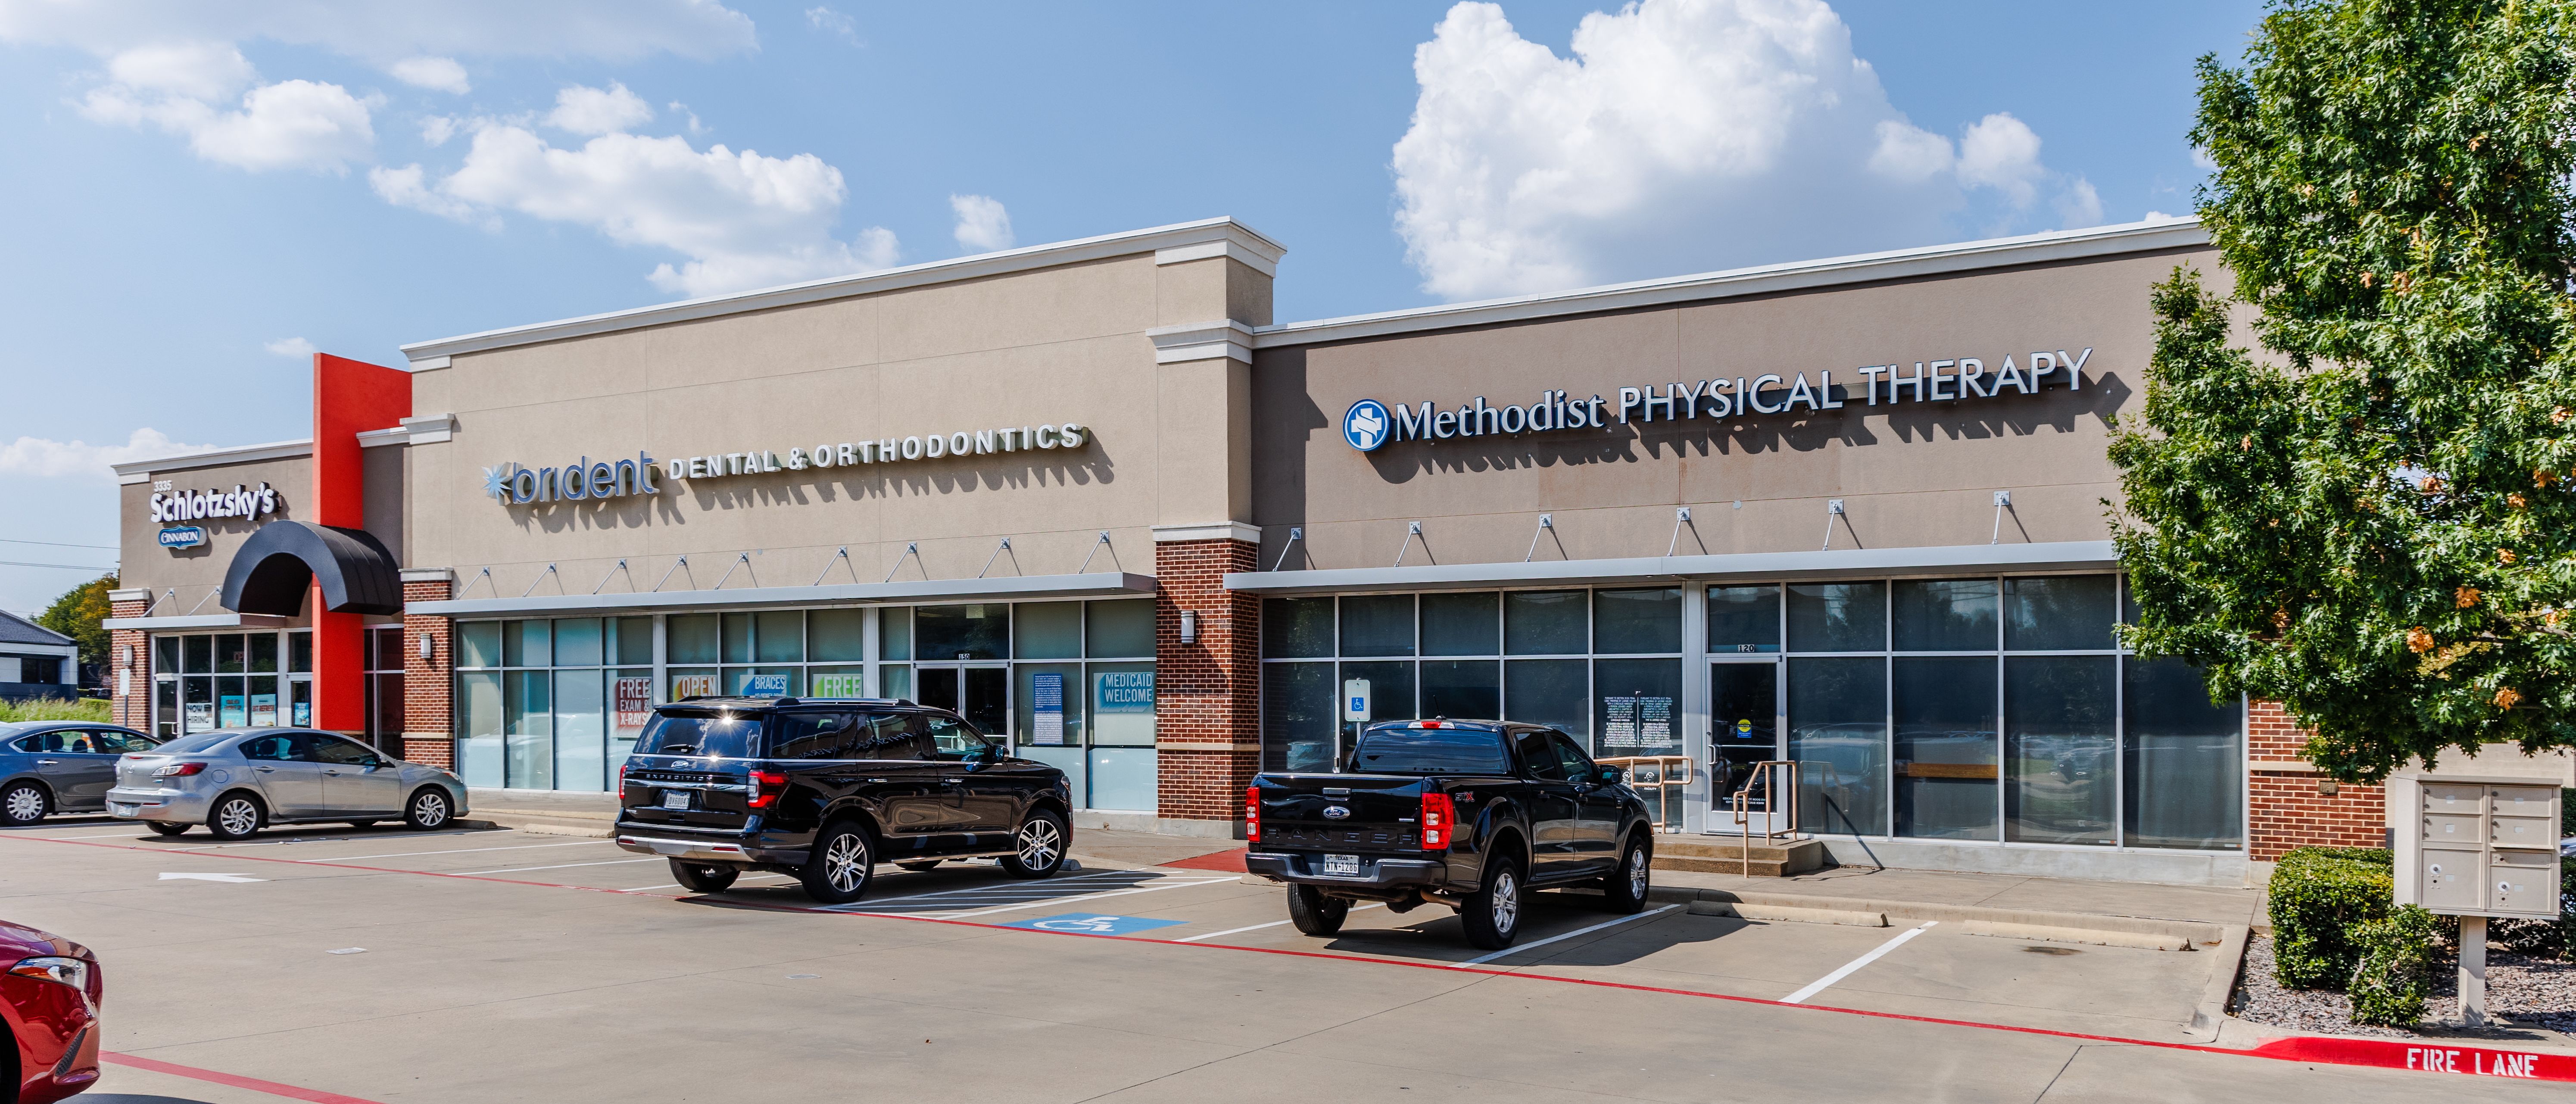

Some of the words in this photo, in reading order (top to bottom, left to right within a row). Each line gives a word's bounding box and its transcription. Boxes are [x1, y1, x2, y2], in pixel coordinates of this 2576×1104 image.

[1396, 389, 1607, 442] Methodist
[1619, 370, 1844, 424] PHYSICAL
[1858, 347, 2093, 406] THERAPY
[669, 449, 782, 480] DENTAL
[789, 447, 808, 470] &
[814, 422, 1083, 468] ORTHODONTICS
[512, 450, 660, 505] brident
[153, 480, 172, 492] 3335
[150, 481, 277, 523] Schlotzsky's
[161, 531, 198, 543] CINNABON
[682, 676, 716, 697] OPEN
[755, 676, 786, 689] BRACES
[824, 676, 861, 698] FREE
[1106, 674, 1152, 687] MEDICAID
[620, 679, 650, 699] FREE
[1105, 688, 1153, 702] WELCOME
[187, 705, 203, 713] NOW
[621, 699, 641, 712] EXAM
[643, 699, 649, 712] &
[621, 713, 647, 725] X-RAYS
[1455, 792, 1475, 802] STX
[1265, 827, 1416, 845] RANGER
[2407, 1048, 2462, 1073] FIRE
[2475, 1052, 2539, 1077] LANE
